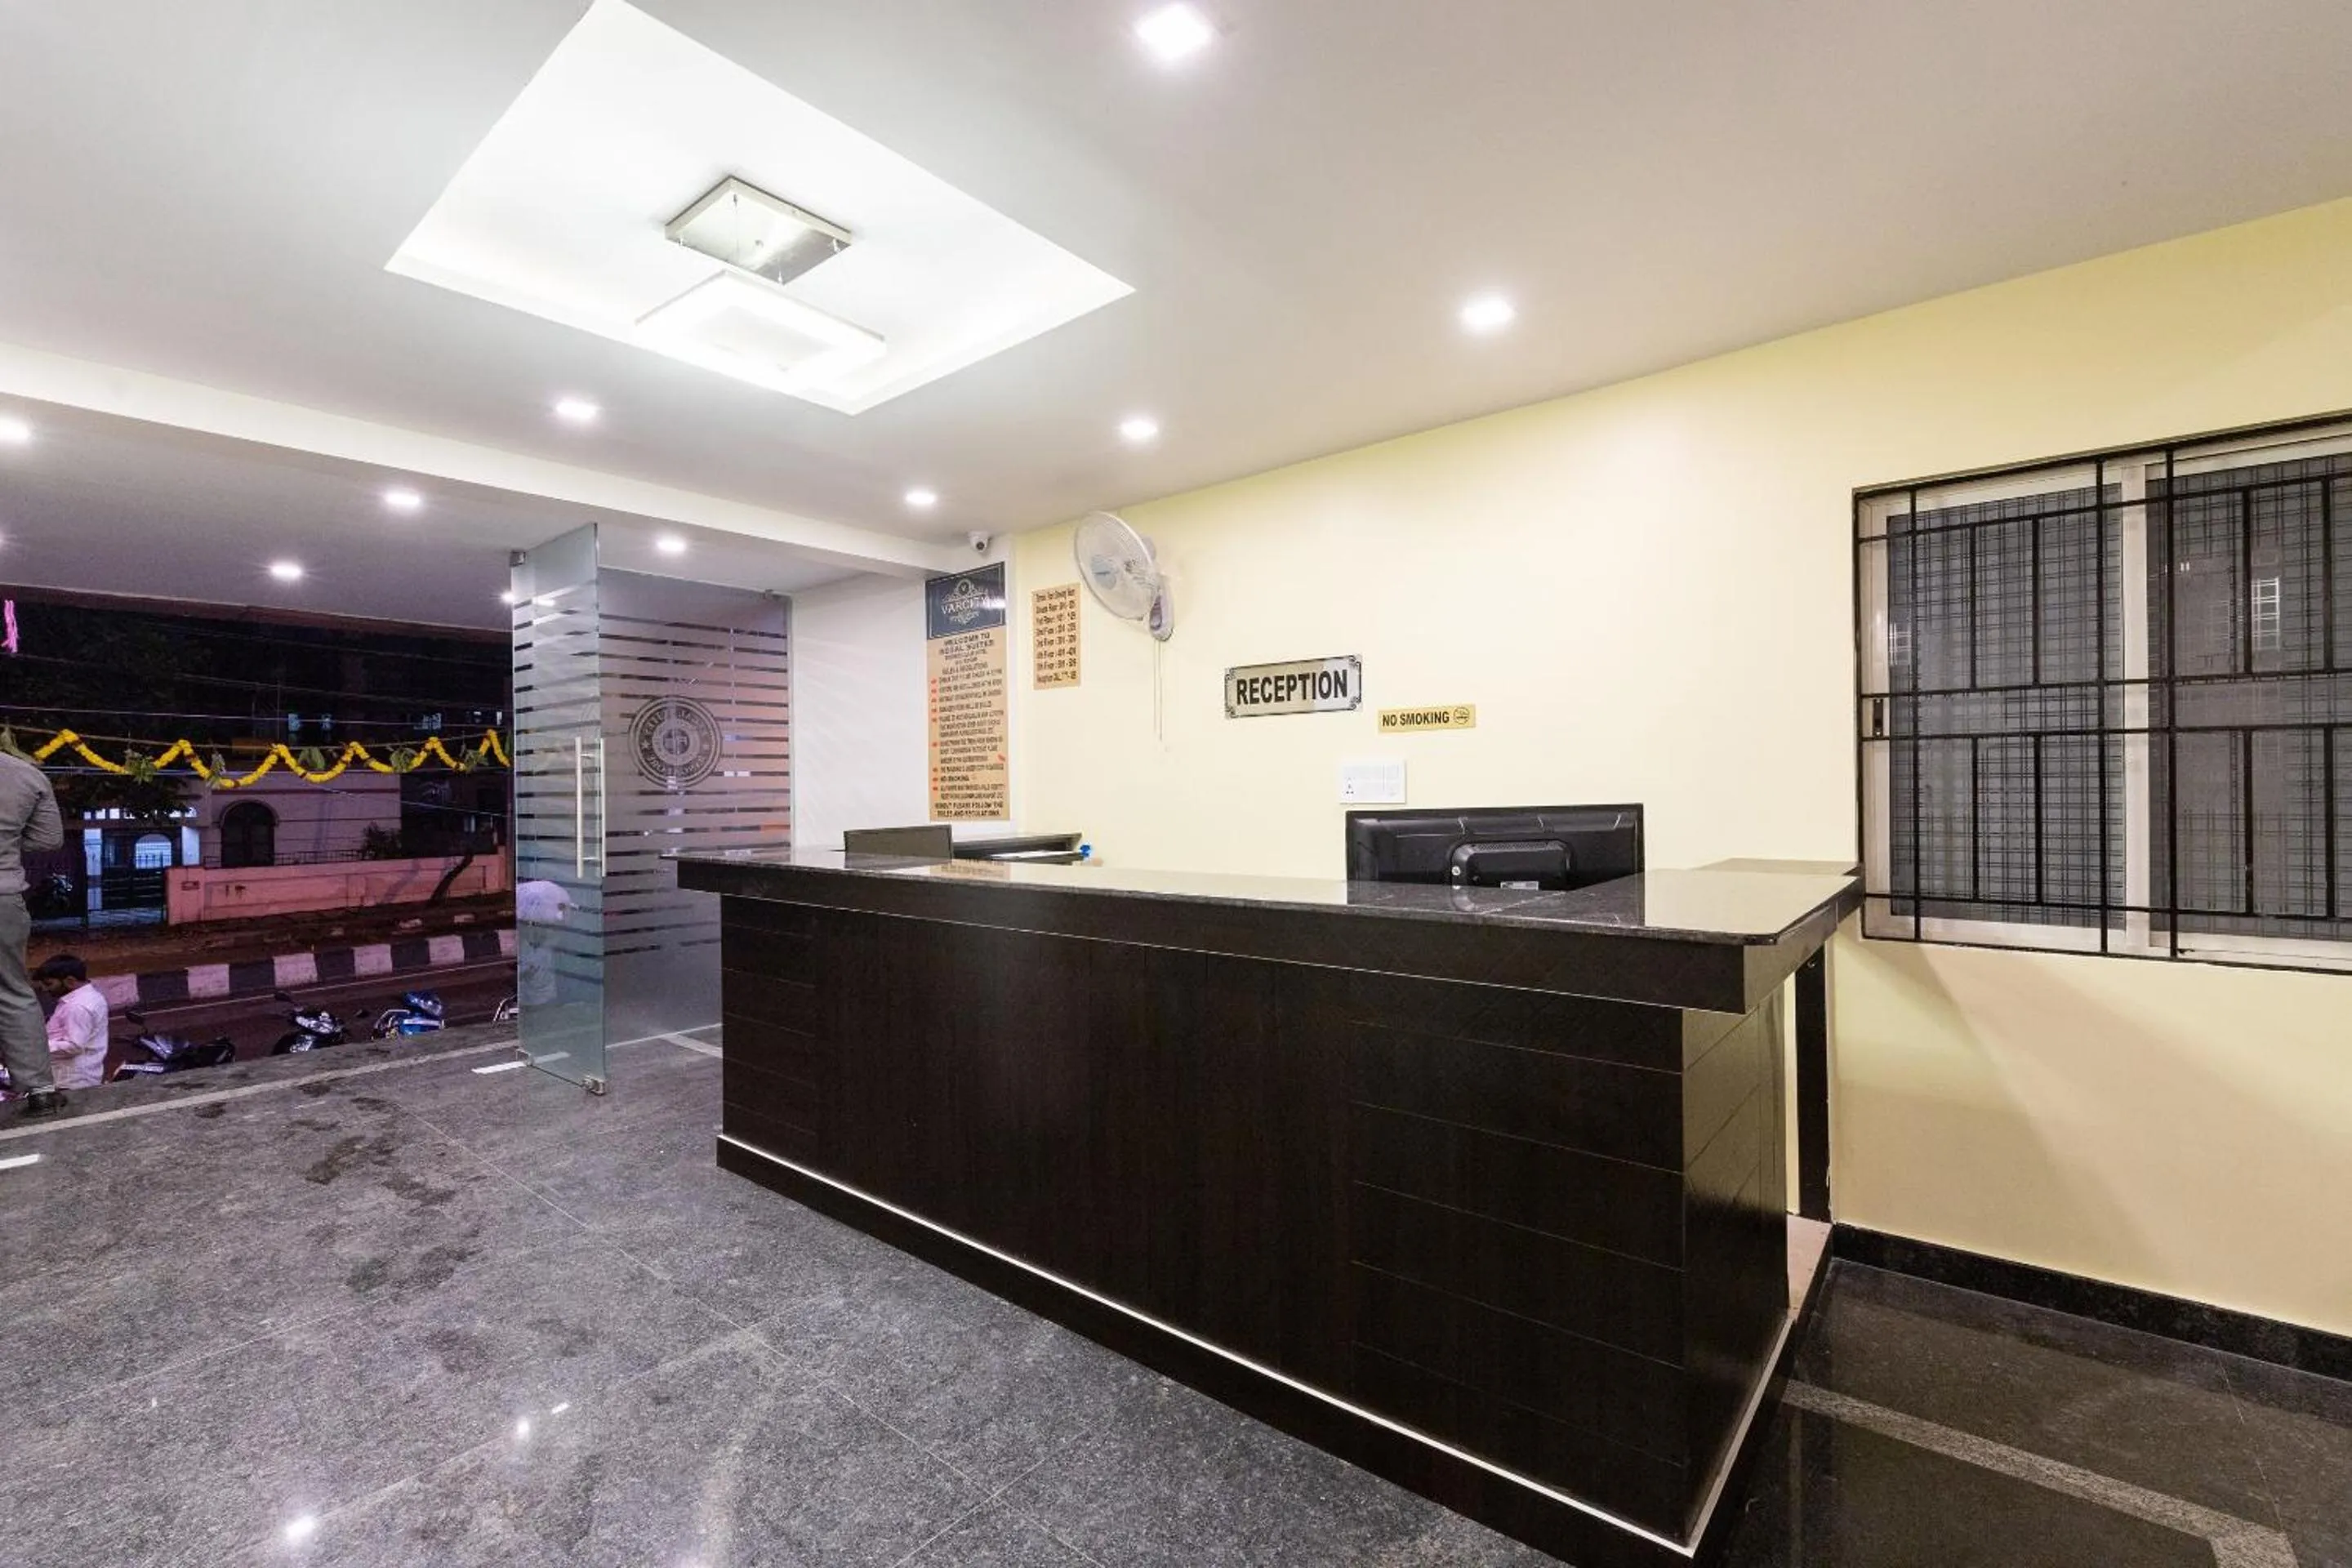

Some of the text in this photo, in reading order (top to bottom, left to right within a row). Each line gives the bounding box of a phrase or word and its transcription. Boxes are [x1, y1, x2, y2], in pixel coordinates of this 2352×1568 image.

[941, 596, 991, 615] VARCITY
[1236, 669, 1348, 706] RECEPTION
[1382, 711, 1450, 727] NO SMOKING
